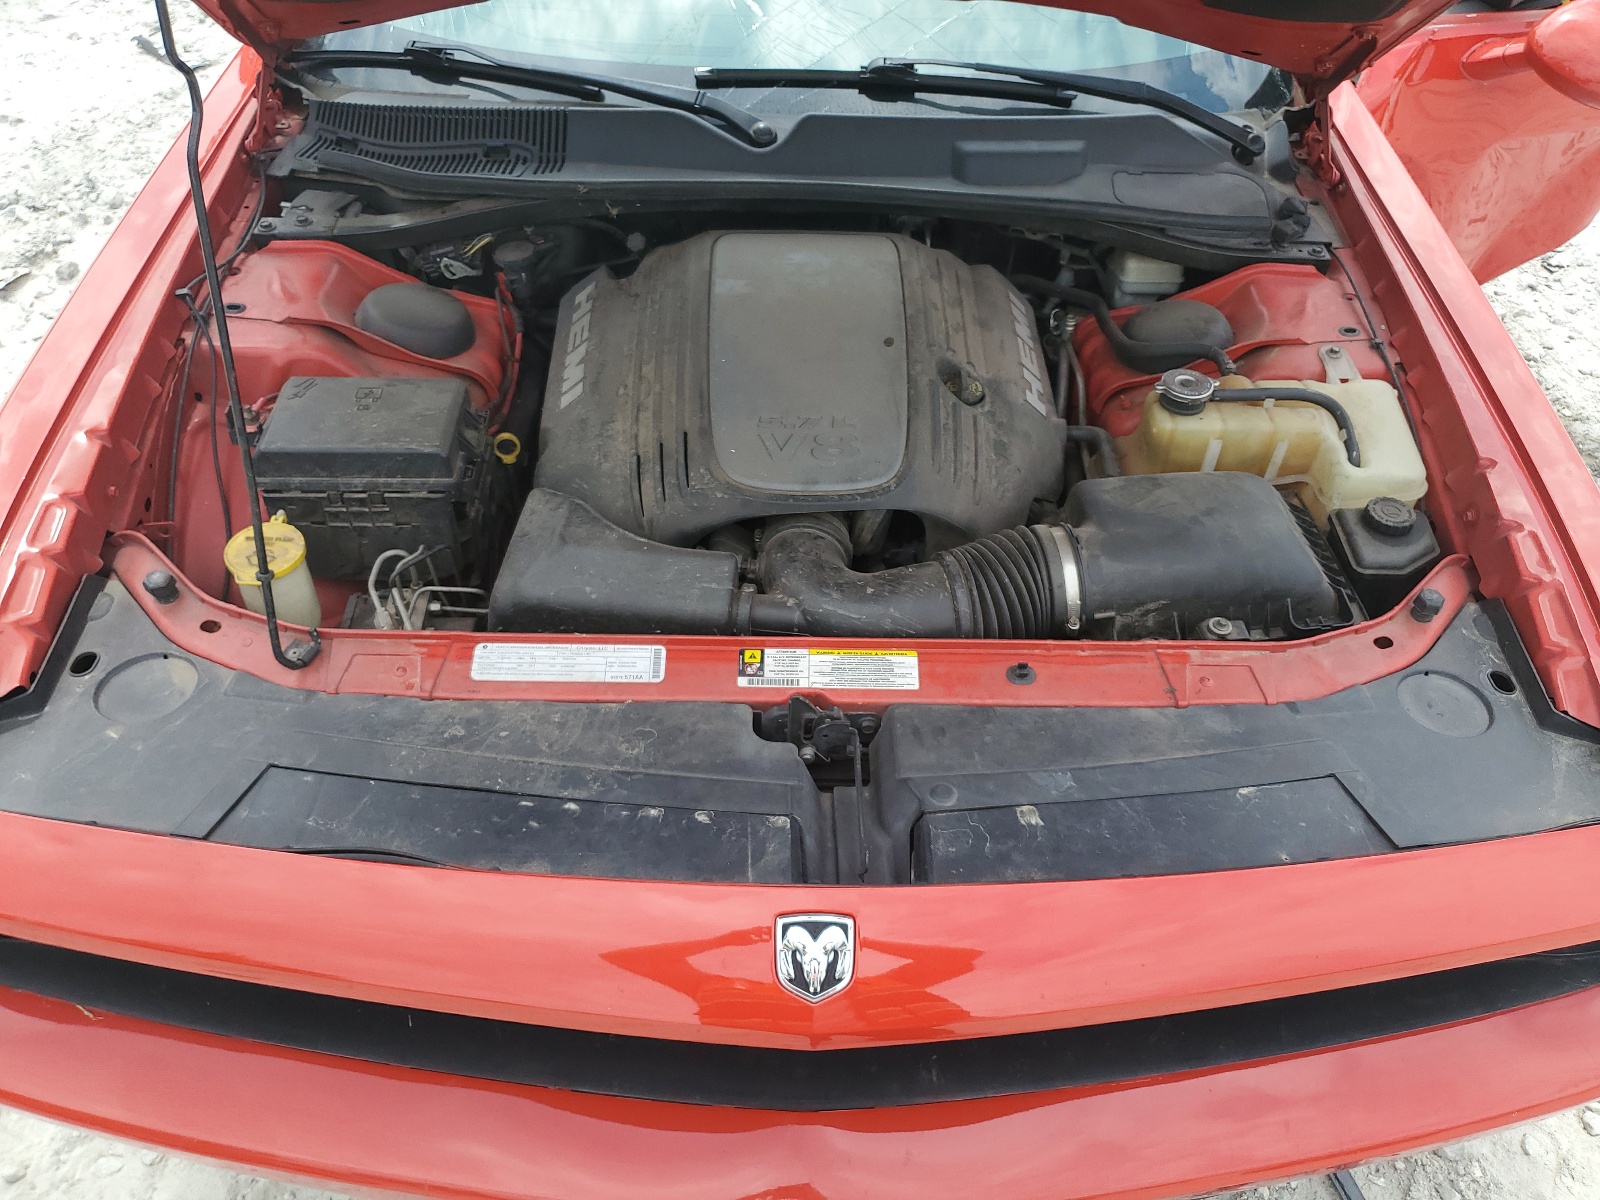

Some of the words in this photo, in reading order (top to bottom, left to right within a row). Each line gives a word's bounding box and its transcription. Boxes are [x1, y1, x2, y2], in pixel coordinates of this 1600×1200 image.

[560, 281, 597, 410] HEMI
[1008, 291, 1047, 417] HEMI
[756, 432, 861, 461] V8
